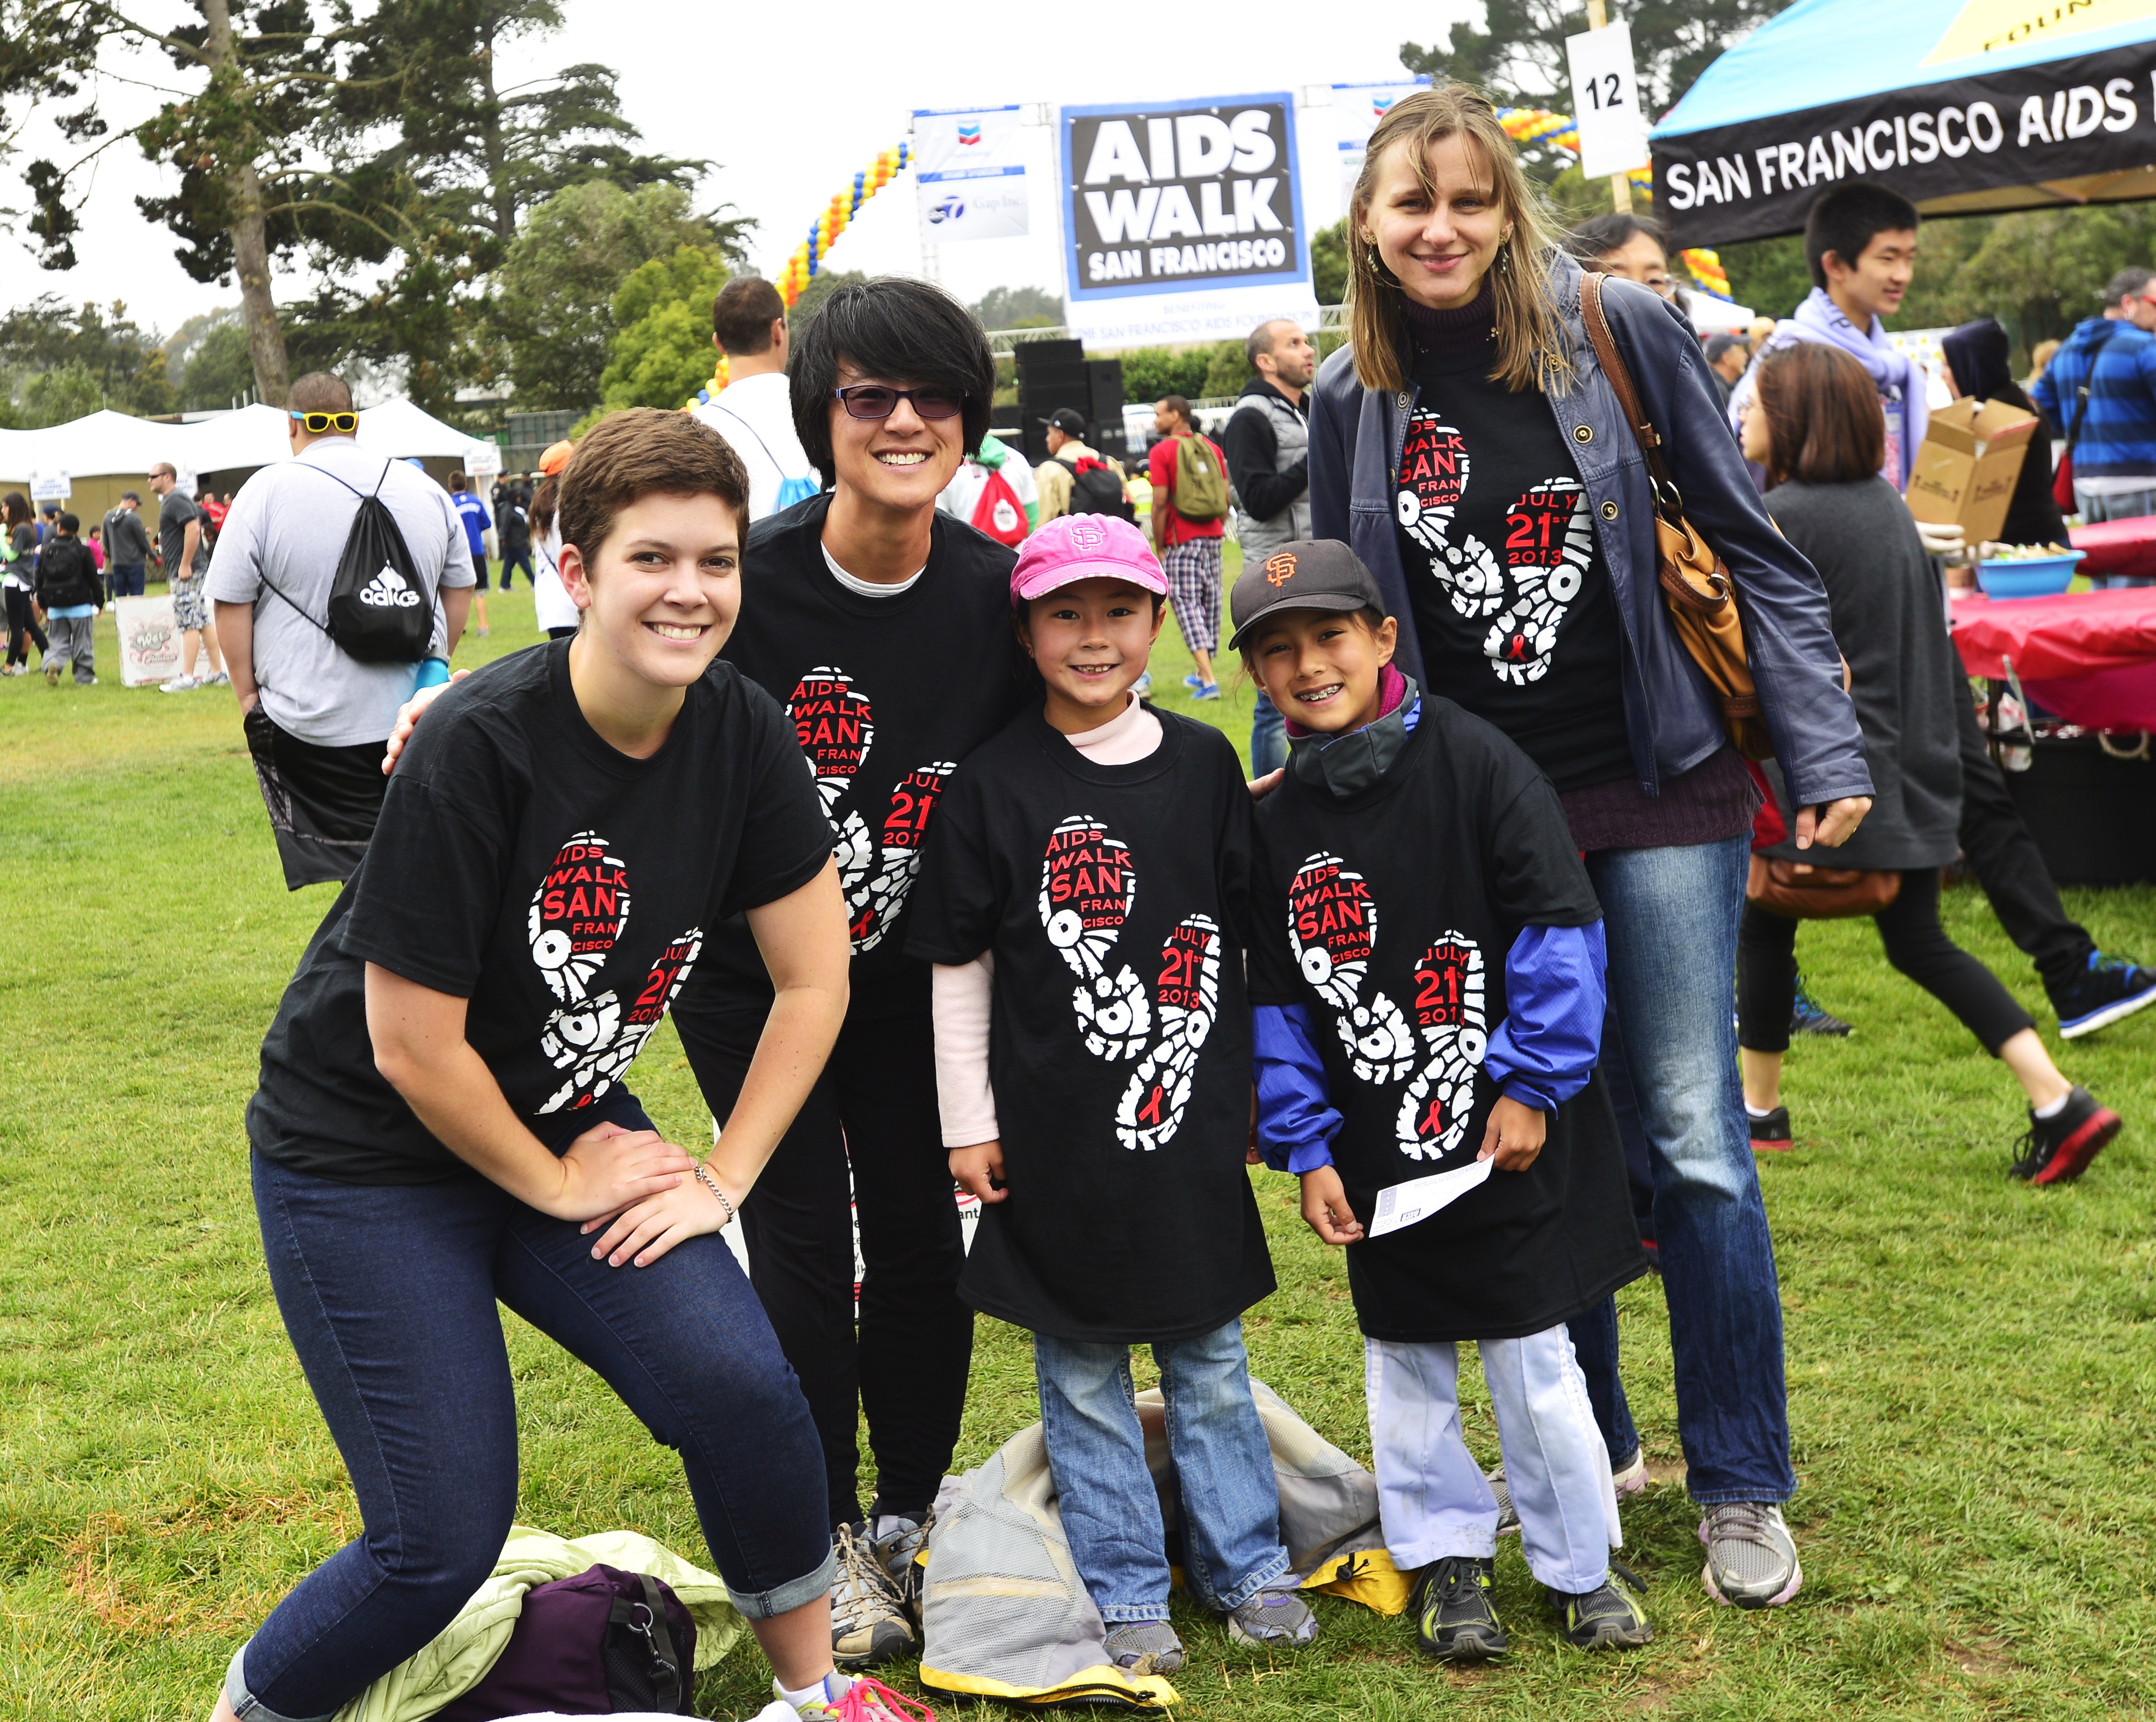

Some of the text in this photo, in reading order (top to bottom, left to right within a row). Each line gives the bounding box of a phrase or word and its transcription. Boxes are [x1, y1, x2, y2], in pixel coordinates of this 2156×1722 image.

[1586, 74, 1622, 110] 12
[1084, 110, 1276, 185] AIDS
[1666, 154, 1751, 210] SAN
[1755, 101, 2003, 194] FRANCISCO
[2017, 78, 2137, 147] AIDS
[972, 197, 1000, 212] Gap
[1084, 178, 1284, 244] WALK
[1088, 238, 1286, 281] SAN FRANCISCO
[1163, 301, 1226, 314] BENEFITING
[1077, 327, 1095, 339] THE
[1101, 325, 1125, 339] SAN
[1129, 319, 1201, 336] FRANCISCO
[1206, 317, 1232, 330] AIDS
[1411, 420, 1436, 434] DS
[1400, 451, 1456, 483] SAN
[1419, 479, 1461, 493] FRAN
[1420, 493, 1460, 507] CISCO
[1515, 493, 1577, 509] JULY
[1508, 549, 1562, 565] 2013
[1266, 552, 1297, 588] SF
[790, 681, 847, 701] AIDS
[794, 700, 873, 721] WALK
[795, 717, 859, 746] SAN
[817, 749, 861, 760] FRAN
[817, 765, 856, 775] CISCO
[902, 773, 941, 792] JUL
[882, 831, 920, 846] 201
[1045, 830, 1103, 858] AIDS
[1051, 848, 1133, 874] WALK
[547, 866, 628, 889] WALK
[1051, 866, 1121, 903] SAN
[1289, 866, 1339, 895] AIDS
[543, 887, 616, 920] SAN
[1080, 898, 1126, 912] FRAN
[1294, 882, 1371, 912] WALK
[572, 922, 619, 935] FRAN
[1083, 916, 1124, 928] CISCO
[1298, 900, 1362, 940] SAN
[572, 939, 613, 952] CISCO
[1171, 927, 1211, 949] JULY
[1328, 931, 1370, 949] FRAN
[1331, 947, 1370, 964] CISCO
[1422, 946, 1470, 967] JULY
[1157, 989, 1200, 1009] 2013
